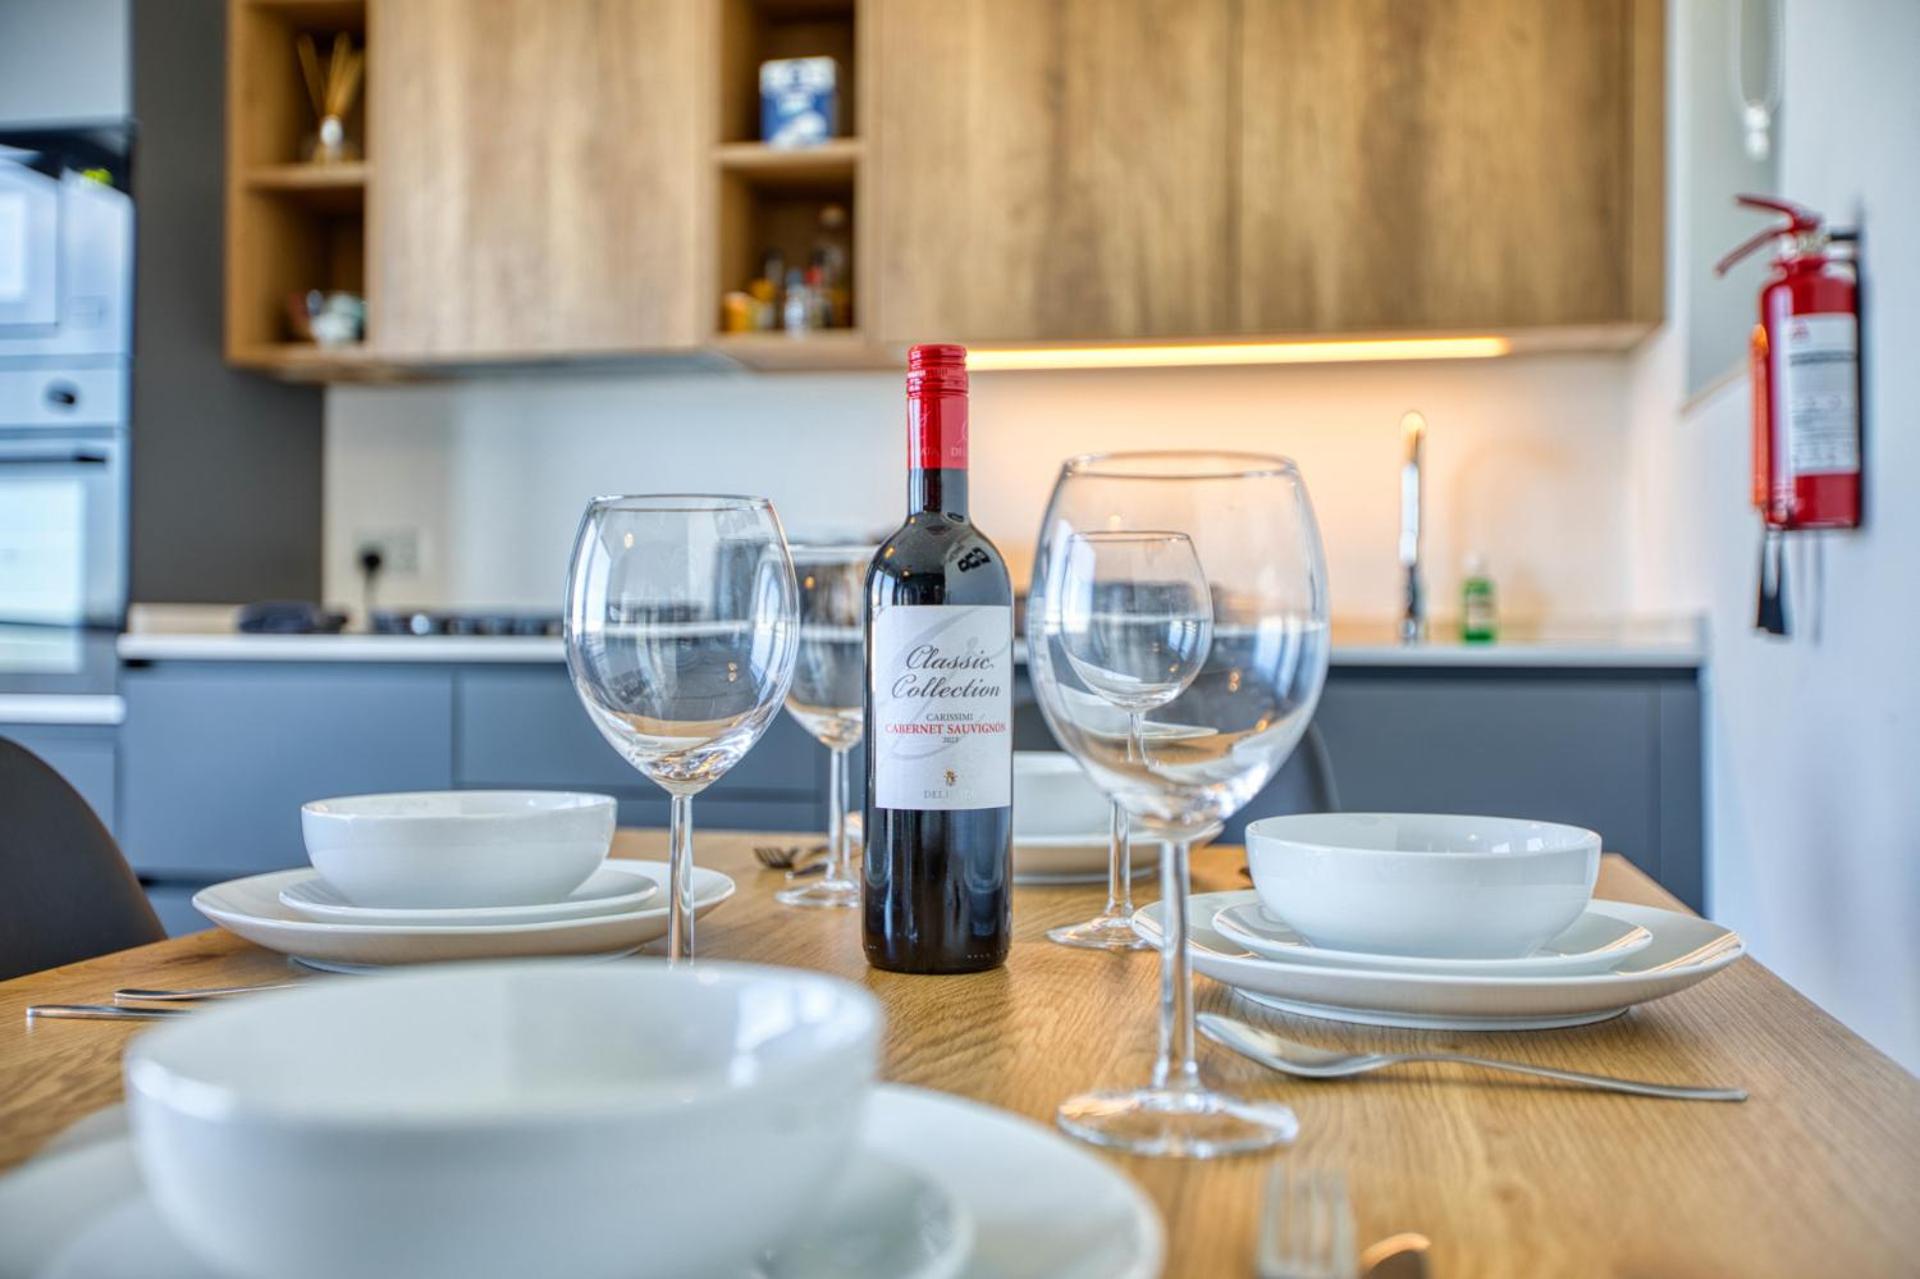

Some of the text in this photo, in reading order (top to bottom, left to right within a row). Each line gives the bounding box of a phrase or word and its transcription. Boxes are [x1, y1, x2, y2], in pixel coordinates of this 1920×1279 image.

[906, 644, 993, 670] Classic
[891, 673, 1000, 699] Collection
[926, 713, 973, 721] CARISSIMI
[885, 723, 943, 734] CABERNET
